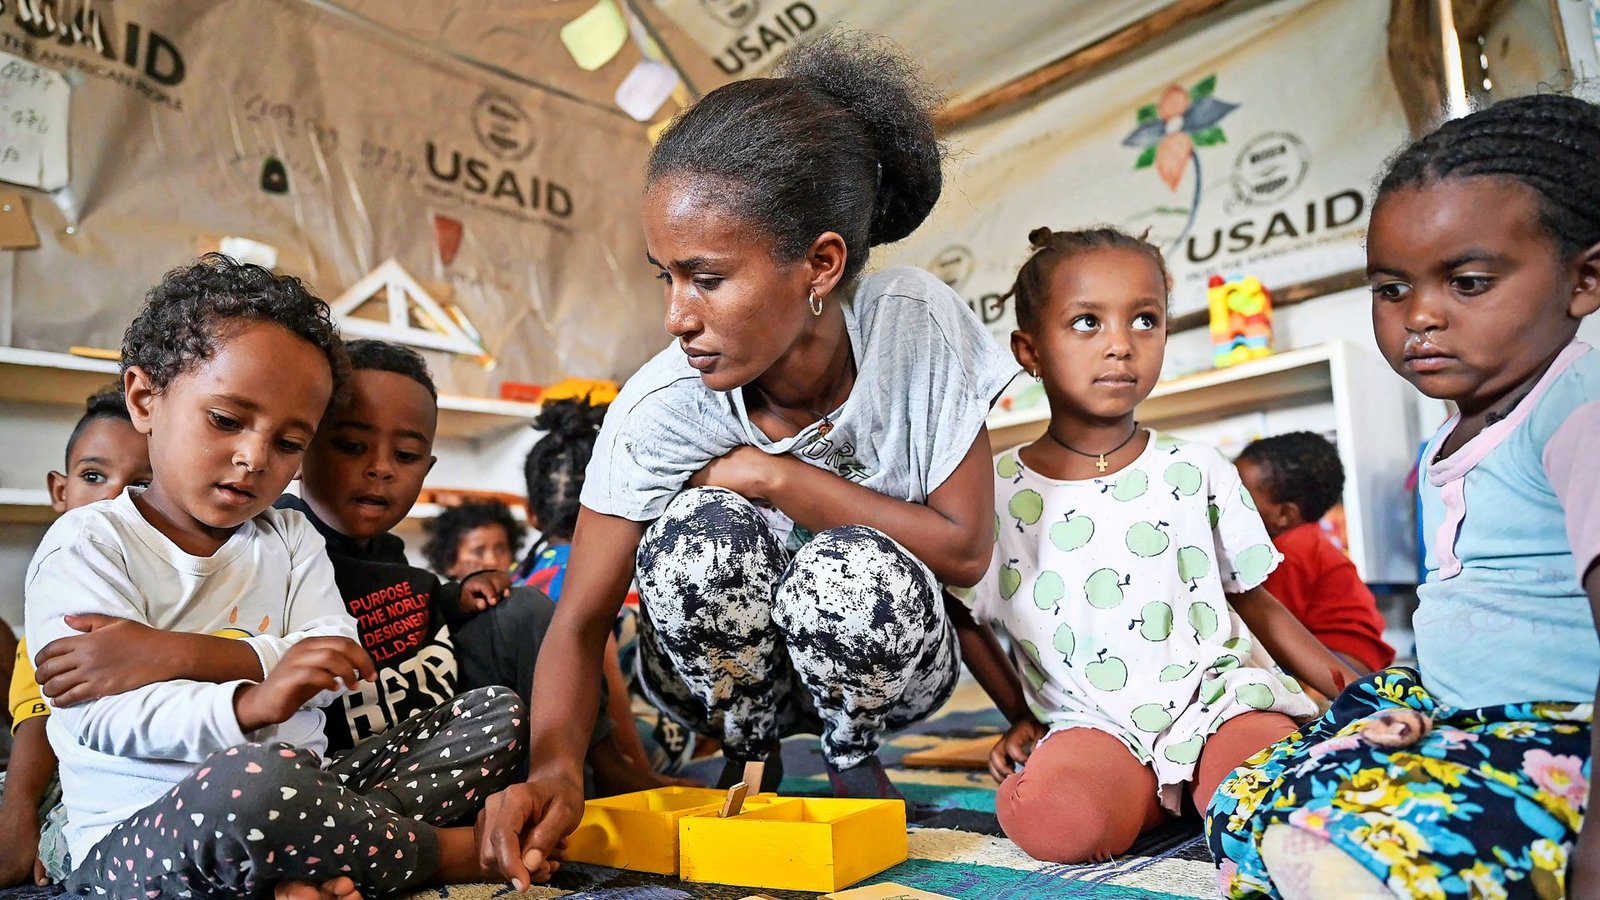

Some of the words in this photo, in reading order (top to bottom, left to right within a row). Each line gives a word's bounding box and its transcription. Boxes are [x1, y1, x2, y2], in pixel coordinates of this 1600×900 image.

[712, 2, 818, 75] USAID
[425, 141, 575, 219] USAID
[1186, 189, 1364, 262] USAID
[349, 581, 412, 615] PURPOSE
[358, 608, 386, 629] THE
